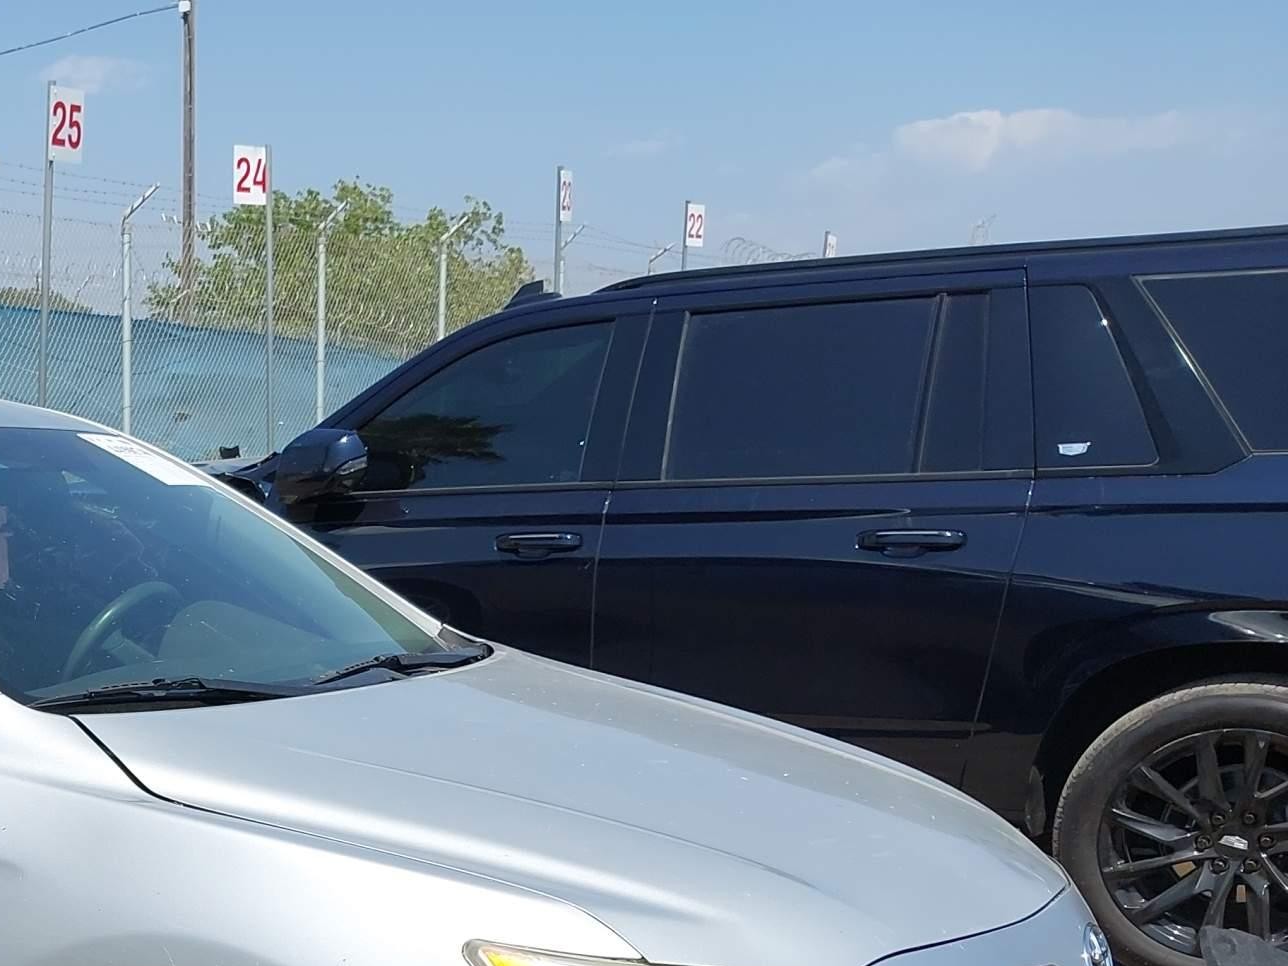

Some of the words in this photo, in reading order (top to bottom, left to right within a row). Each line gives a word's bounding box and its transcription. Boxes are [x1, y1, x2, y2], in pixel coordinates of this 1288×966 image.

[51, 100, 82, 150] 25
[236, 157, 267, 194] 24
[688, 212, 703, 239] 22
